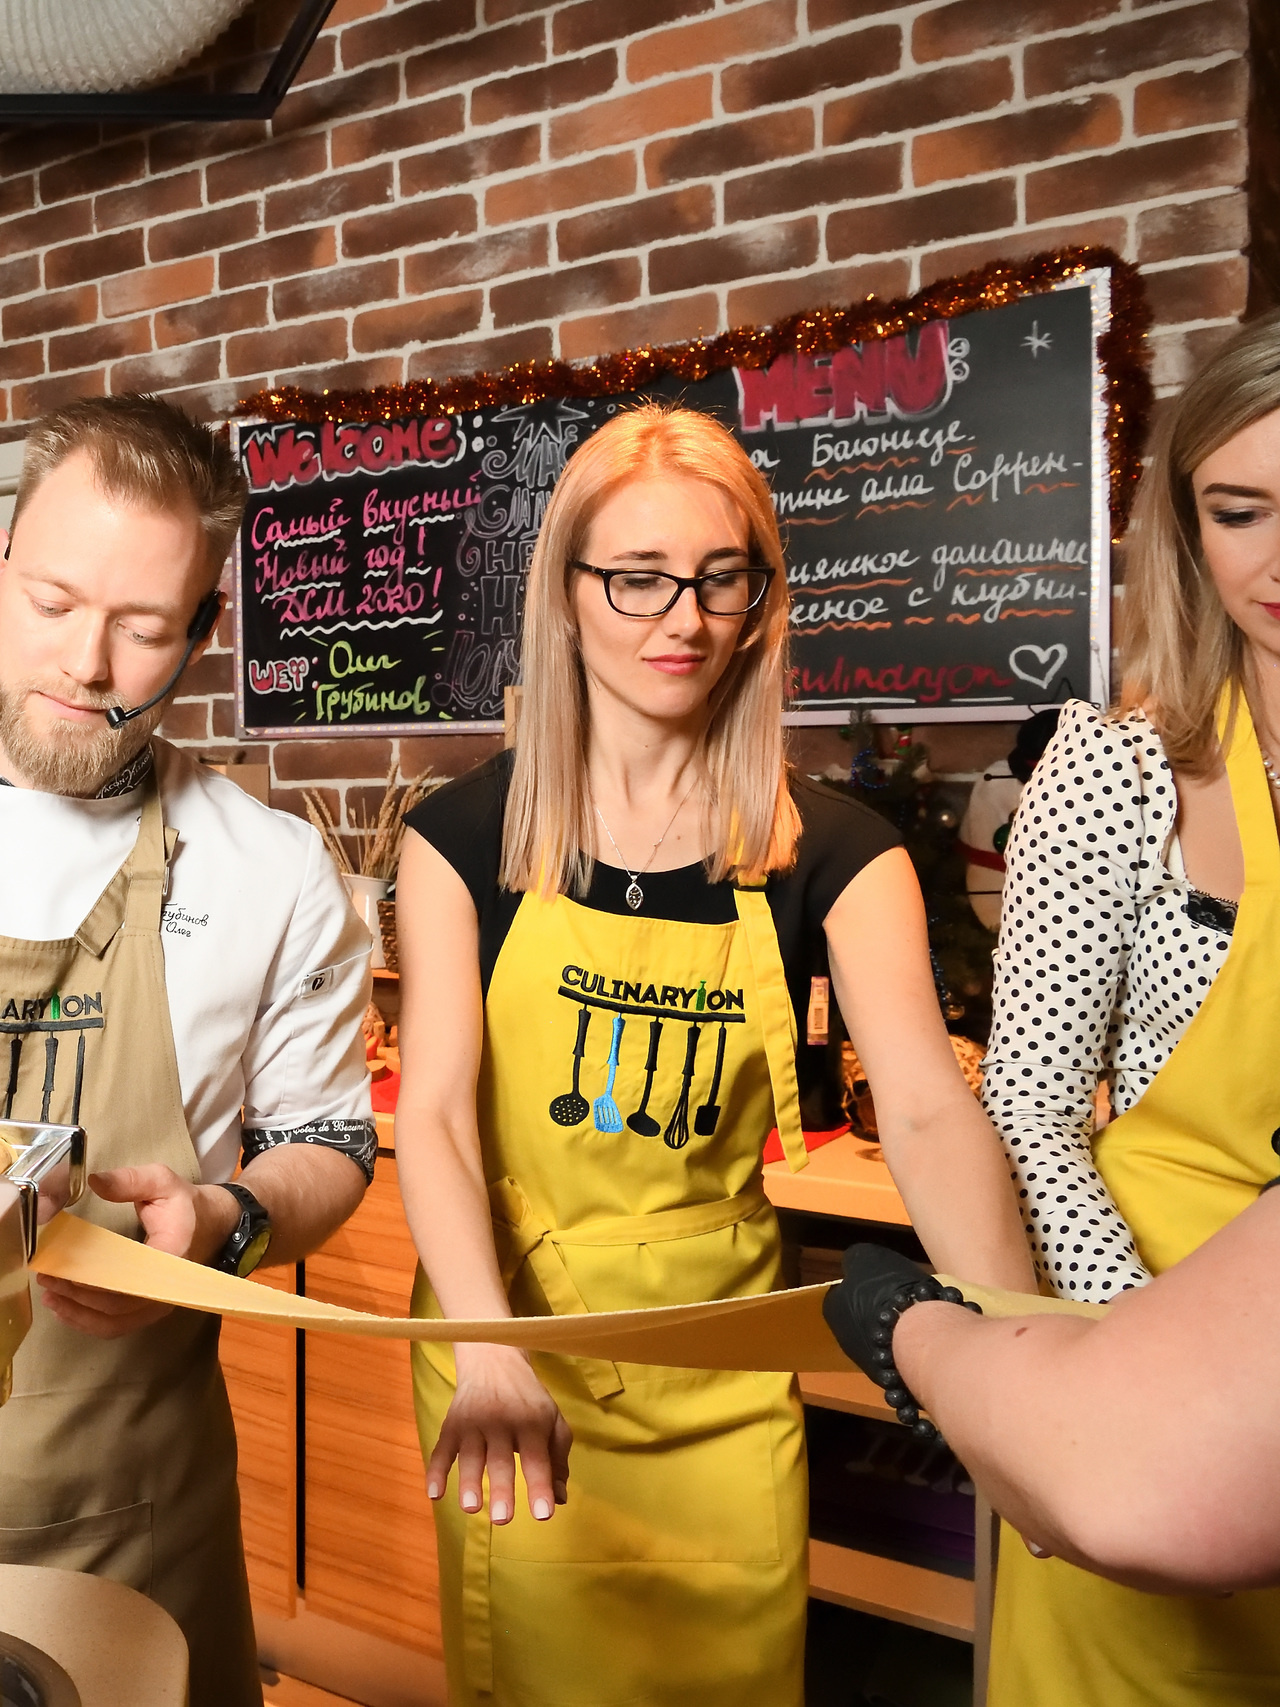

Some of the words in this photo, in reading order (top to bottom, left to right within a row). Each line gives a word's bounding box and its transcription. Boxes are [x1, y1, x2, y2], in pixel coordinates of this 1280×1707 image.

[732, 320, 954, 433] MENU
[251, 498, 351, 550] Самый
[362, 468, 482, 545] вкусный
[255, 538, 351, 593] Новый
[315, 675, 431, 724] Грубинов
